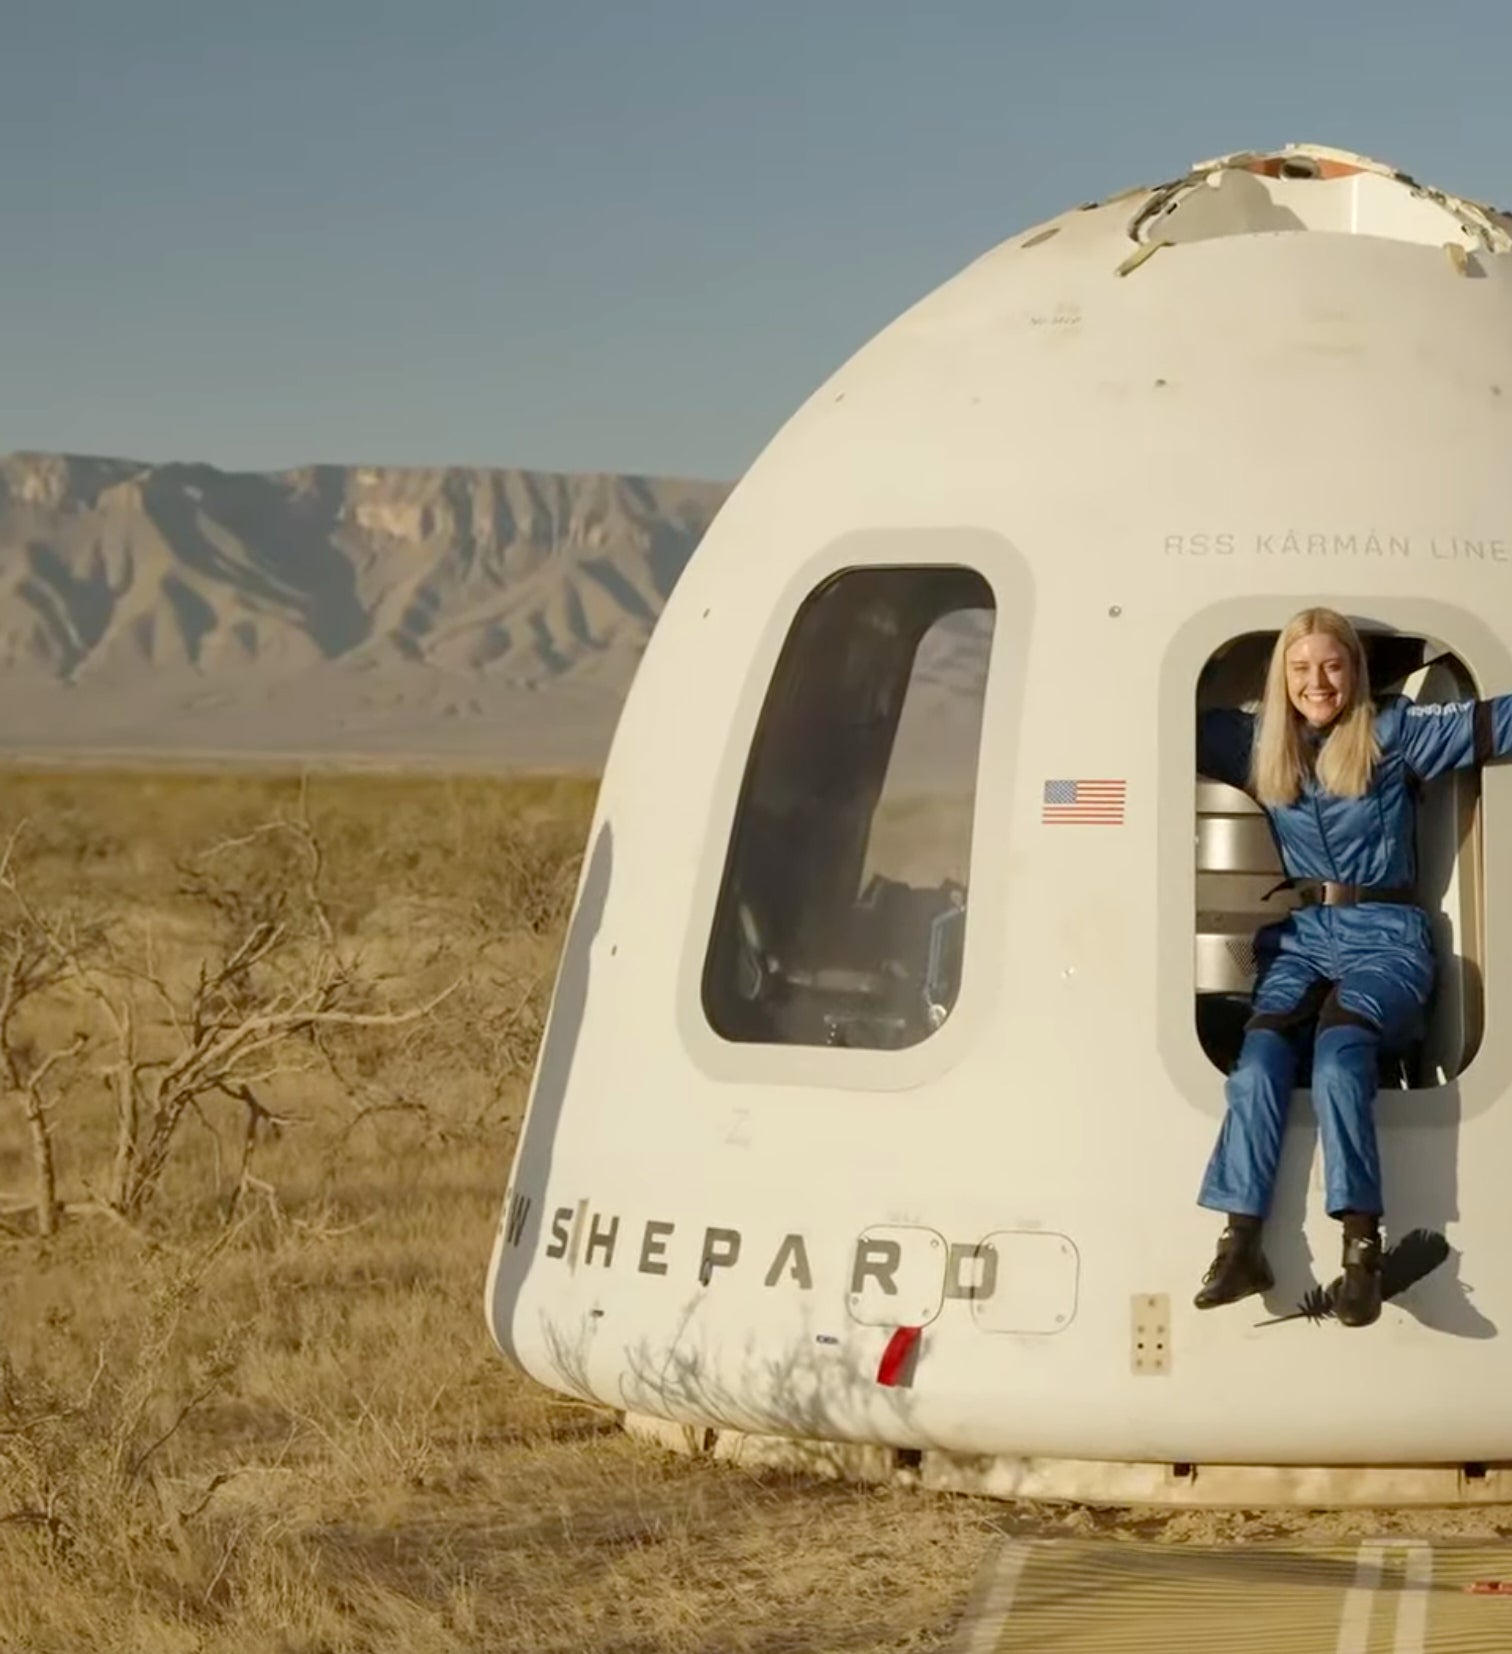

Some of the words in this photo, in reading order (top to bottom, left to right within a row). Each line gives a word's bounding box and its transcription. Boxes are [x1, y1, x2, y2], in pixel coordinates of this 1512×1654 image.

[1164, 533, 1236, 556] RSS
[1431, 536, 1510, 562] LINE
[545, 1207, 999, 1300] SHEPARD
